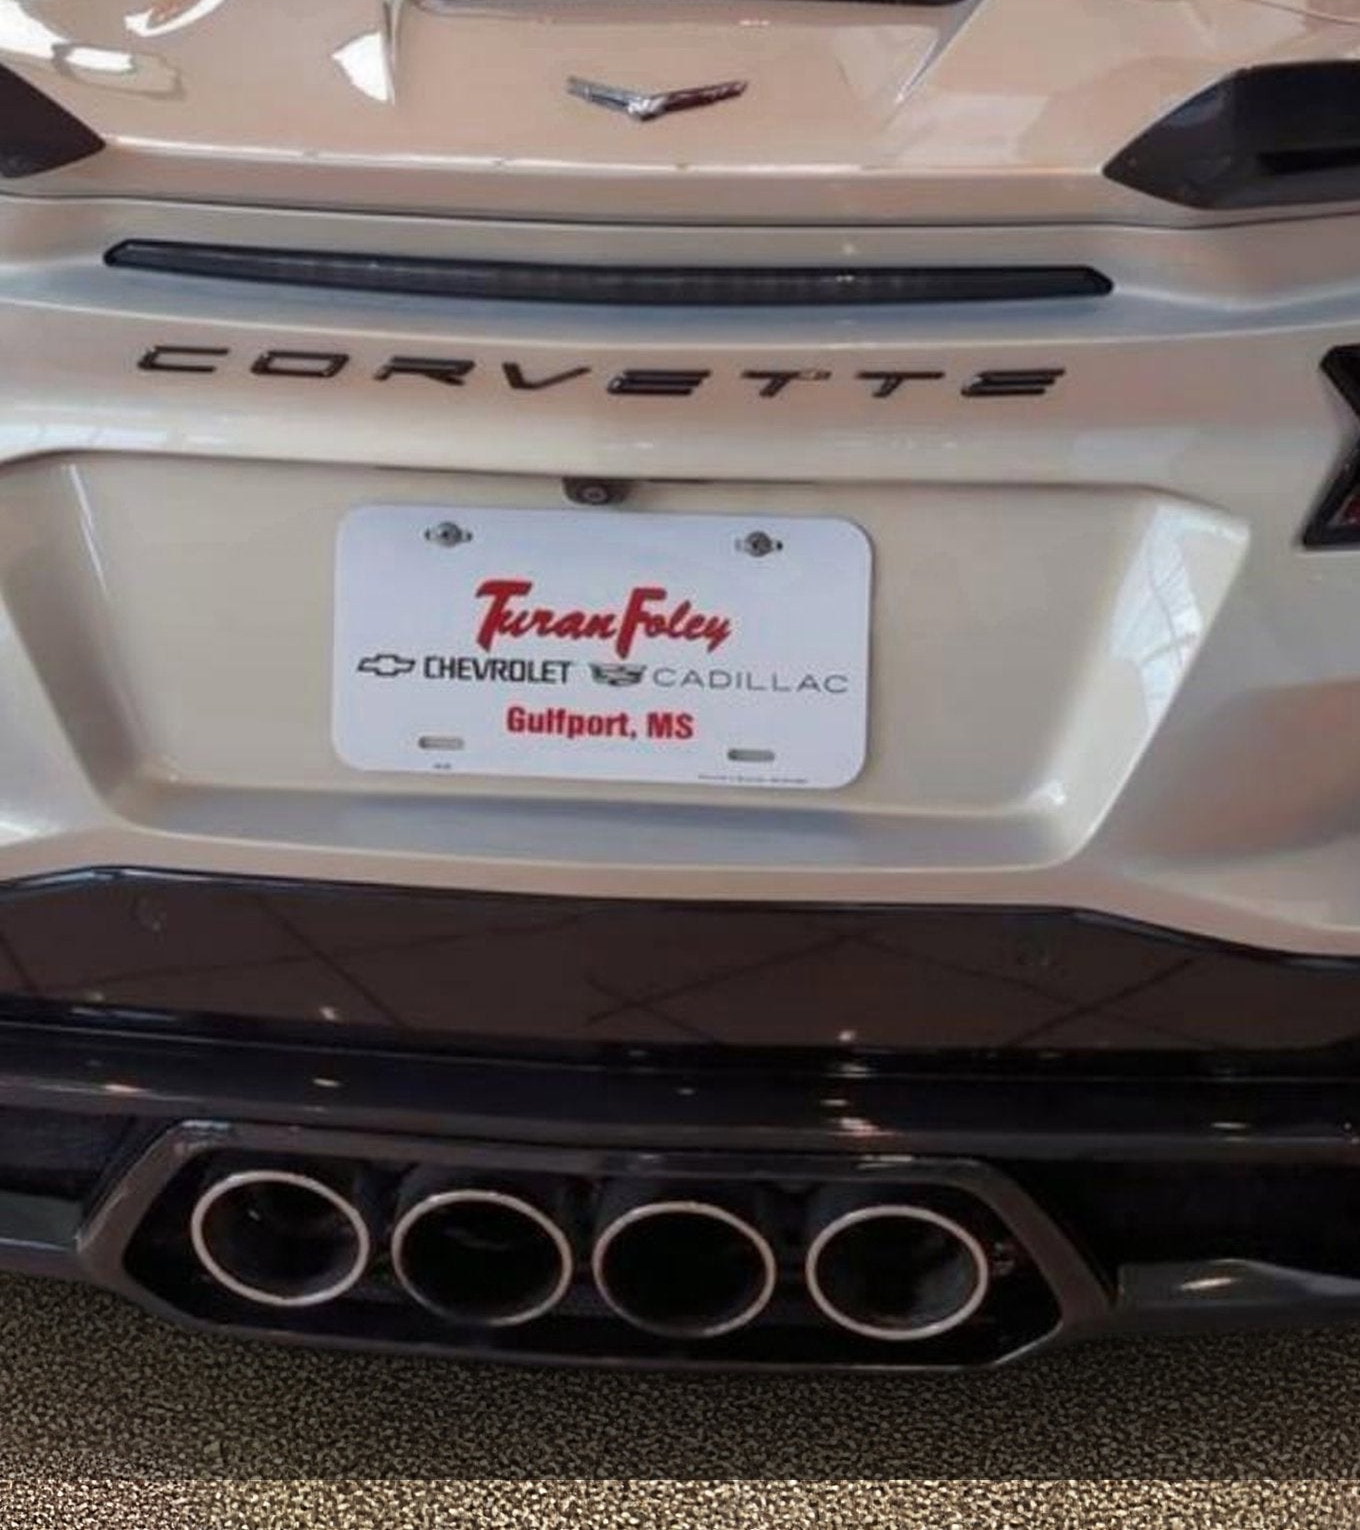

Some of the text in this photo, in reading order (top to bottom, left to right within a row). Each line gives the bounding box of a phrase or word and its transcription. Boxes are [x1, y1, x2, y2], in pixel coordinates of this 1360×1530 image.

[137, 344, 1067, 398] CORVETTE
[475, 579, 732, 660] Turan Foley
[423, 655, 573, 686] CHEVROLET
[652, 669, 850, 694] CADILLAC
[506, 705, 694, 740] Gulfport, MS
